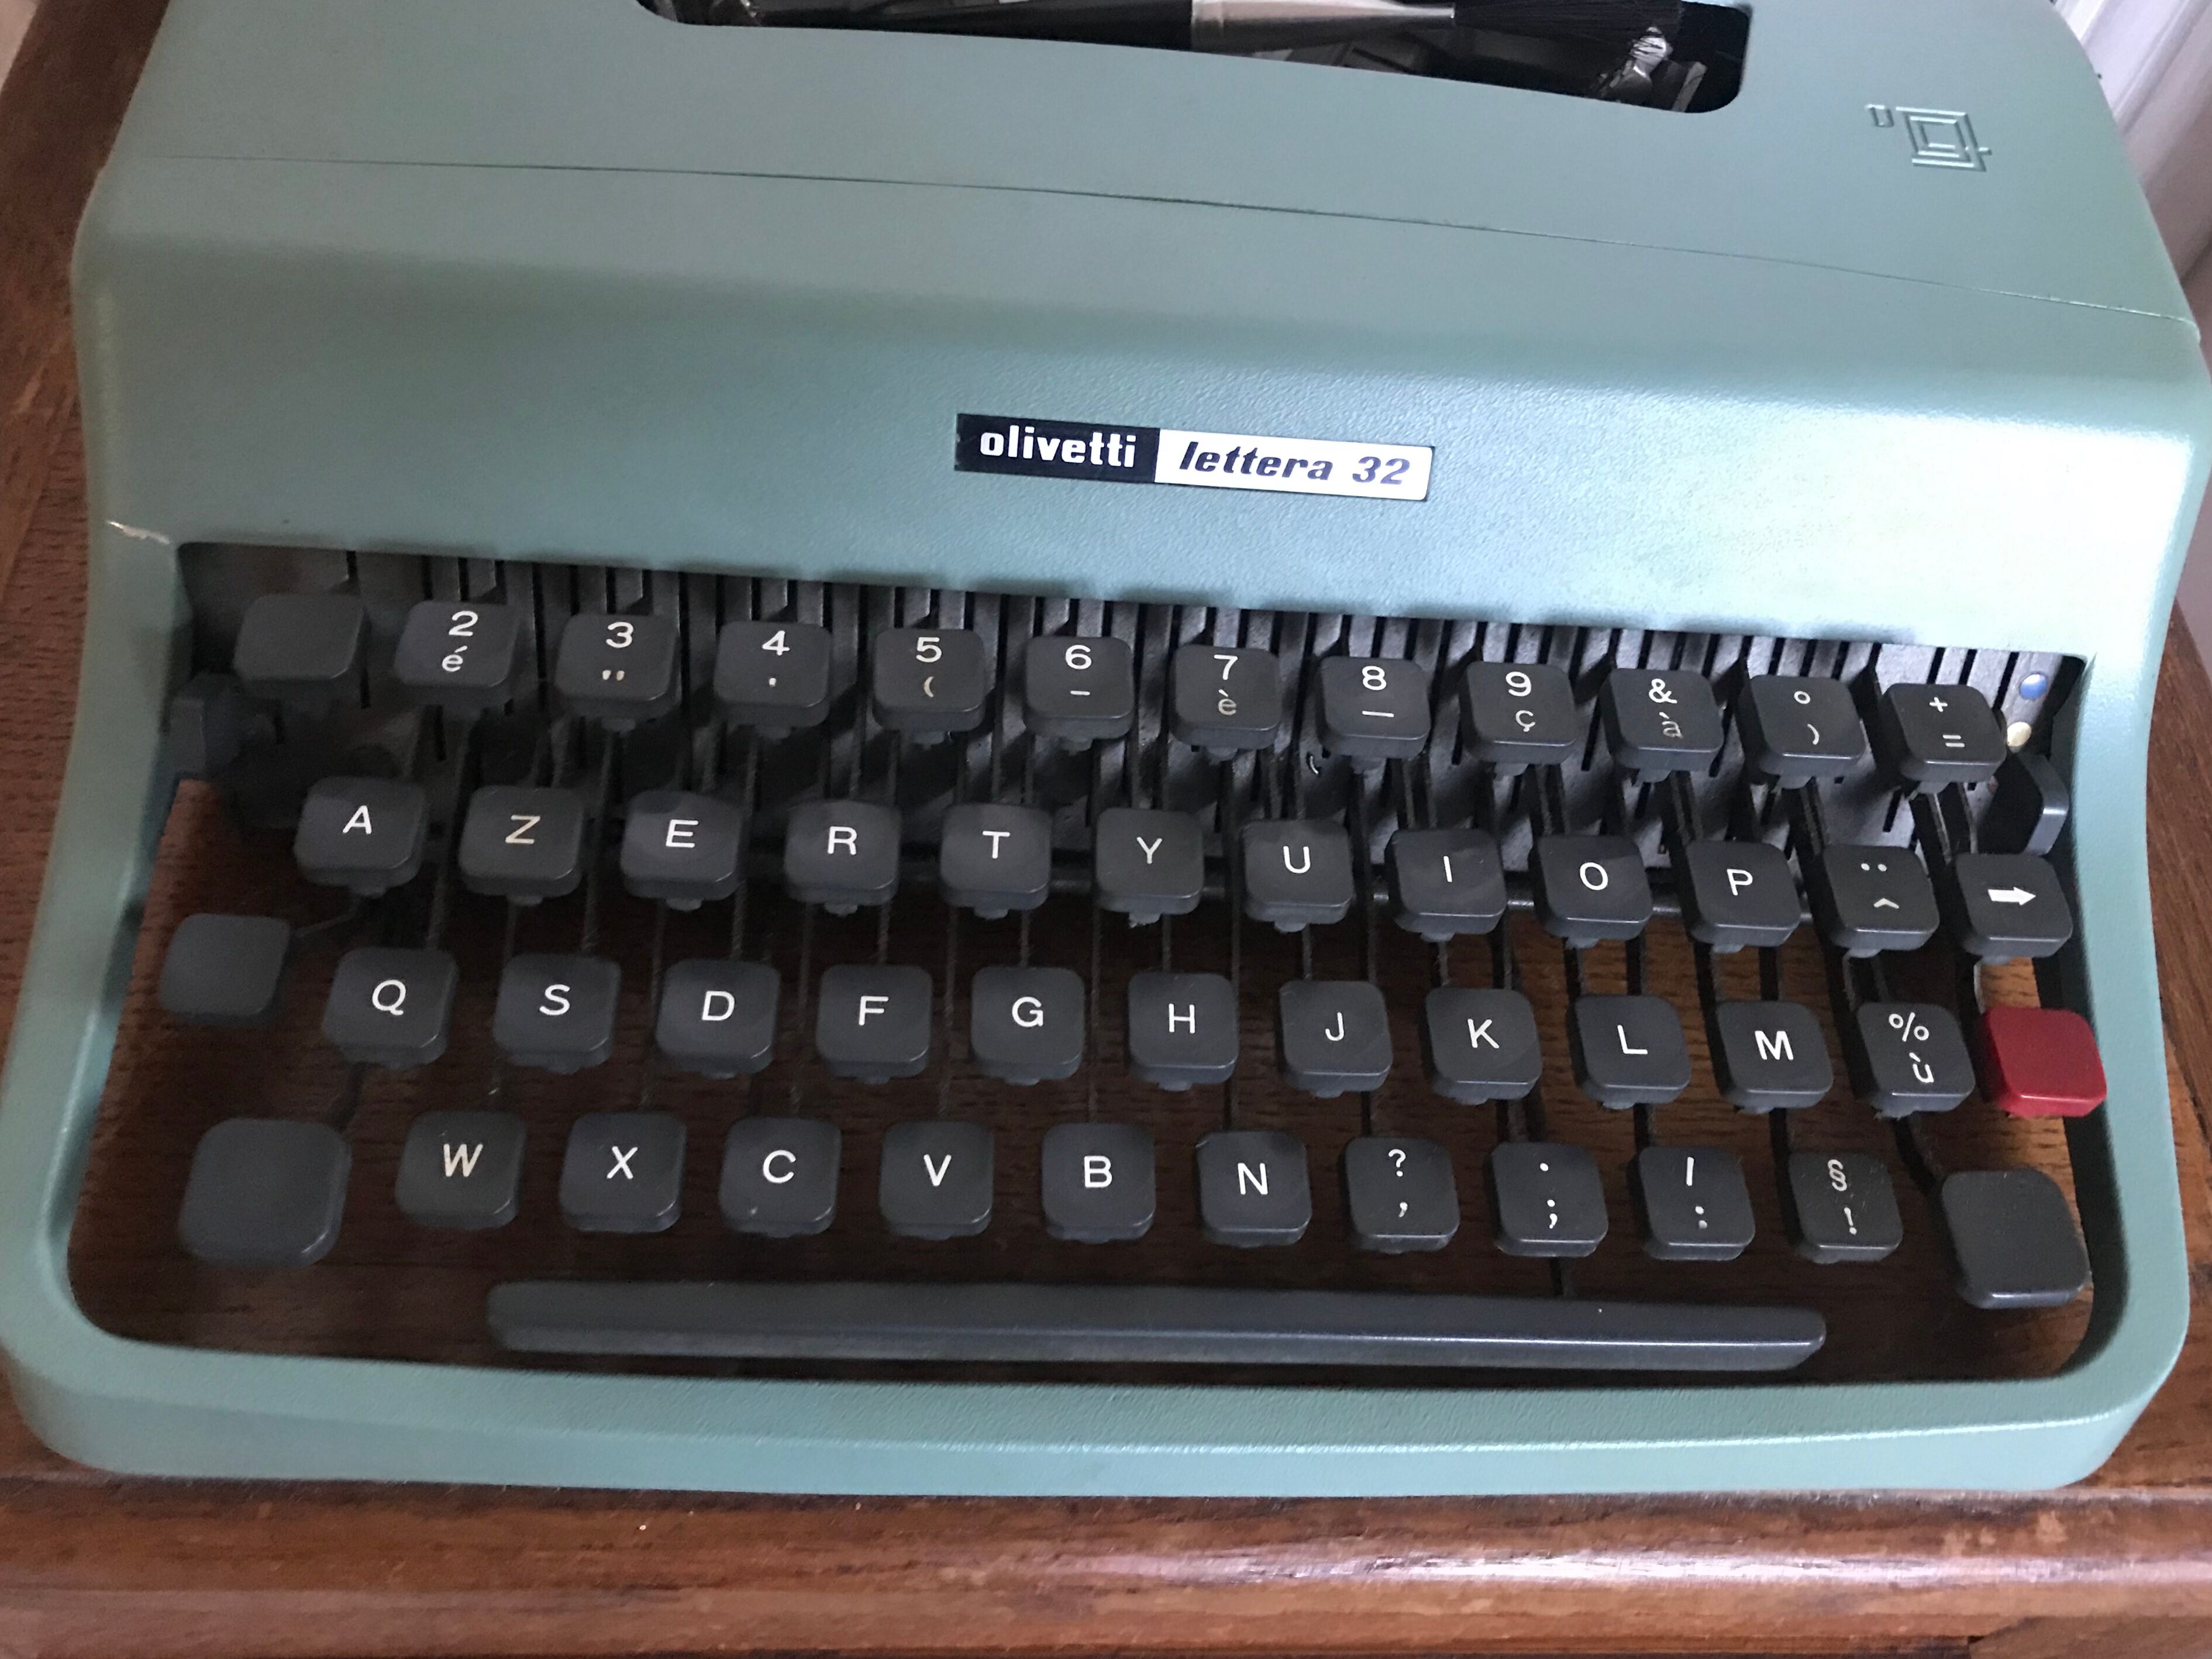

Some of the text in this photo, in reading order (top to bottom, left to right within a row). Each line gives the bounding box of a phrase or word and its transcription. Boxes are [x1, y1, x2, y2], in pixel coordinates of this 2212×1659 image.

[978, 426, 1138, 468] olivetti
[1178, 440, 1412, 486] lettera 32
[447, 610, 479, 637] 2
[605, 621, 635, 649] 3
[761, 629, 791, 656] 4
[915, 636, 943, 663] 5
[1064, 643, 1093, 670] 6
[441, 645, 468, 673] é
[1213, 653, 1239, 681] 7
[1361, 665, 1387, 691] 8
[1505, 670, 1532, 697] 9
[1217, 689, 1237, 715] è
[1515, 709, 1536, 733] ç
[342, 804, 373, 835] A
[504, 814, 541, 845] Z
[664, 818, 699, 849] E
[826, 825, 858, 856] R
[981, 830, 1011, 859] T
[1136, 836, 1163, 865] Y
[1282, 845, 1311, 875] U
[1442, 855, 1453, 883] I
[1579, 861, 1609, 892] O
[1726, 868, 1753, 896] P
[371, 979, 407, 1016] Q
[539, 983, 571, 1016] S
[701, 990, 736, 1022] D
[857, 995, 890, 1027] F
[1011, 996, 1044, 1028] G
[1167, 1003, 1196, 1034] H
[1324, 1011, 1345, 1042] J
[1467, 1018, 1500, 1049] K
[1617, 1024, 1649, 1055] L
[1754, 1030, 1794, 1061] M
[1908, 1051, 1935, 1084] ù
[443, 1142, 484, 1178] W
[606, 1145, 639, 1180] X
[762, 1149, 797, 1184] C
[923, 1154, 952, 1187] V
[1083, 1155, 1113, 1189] B
[1236, 1162, 1269, 1196] N
